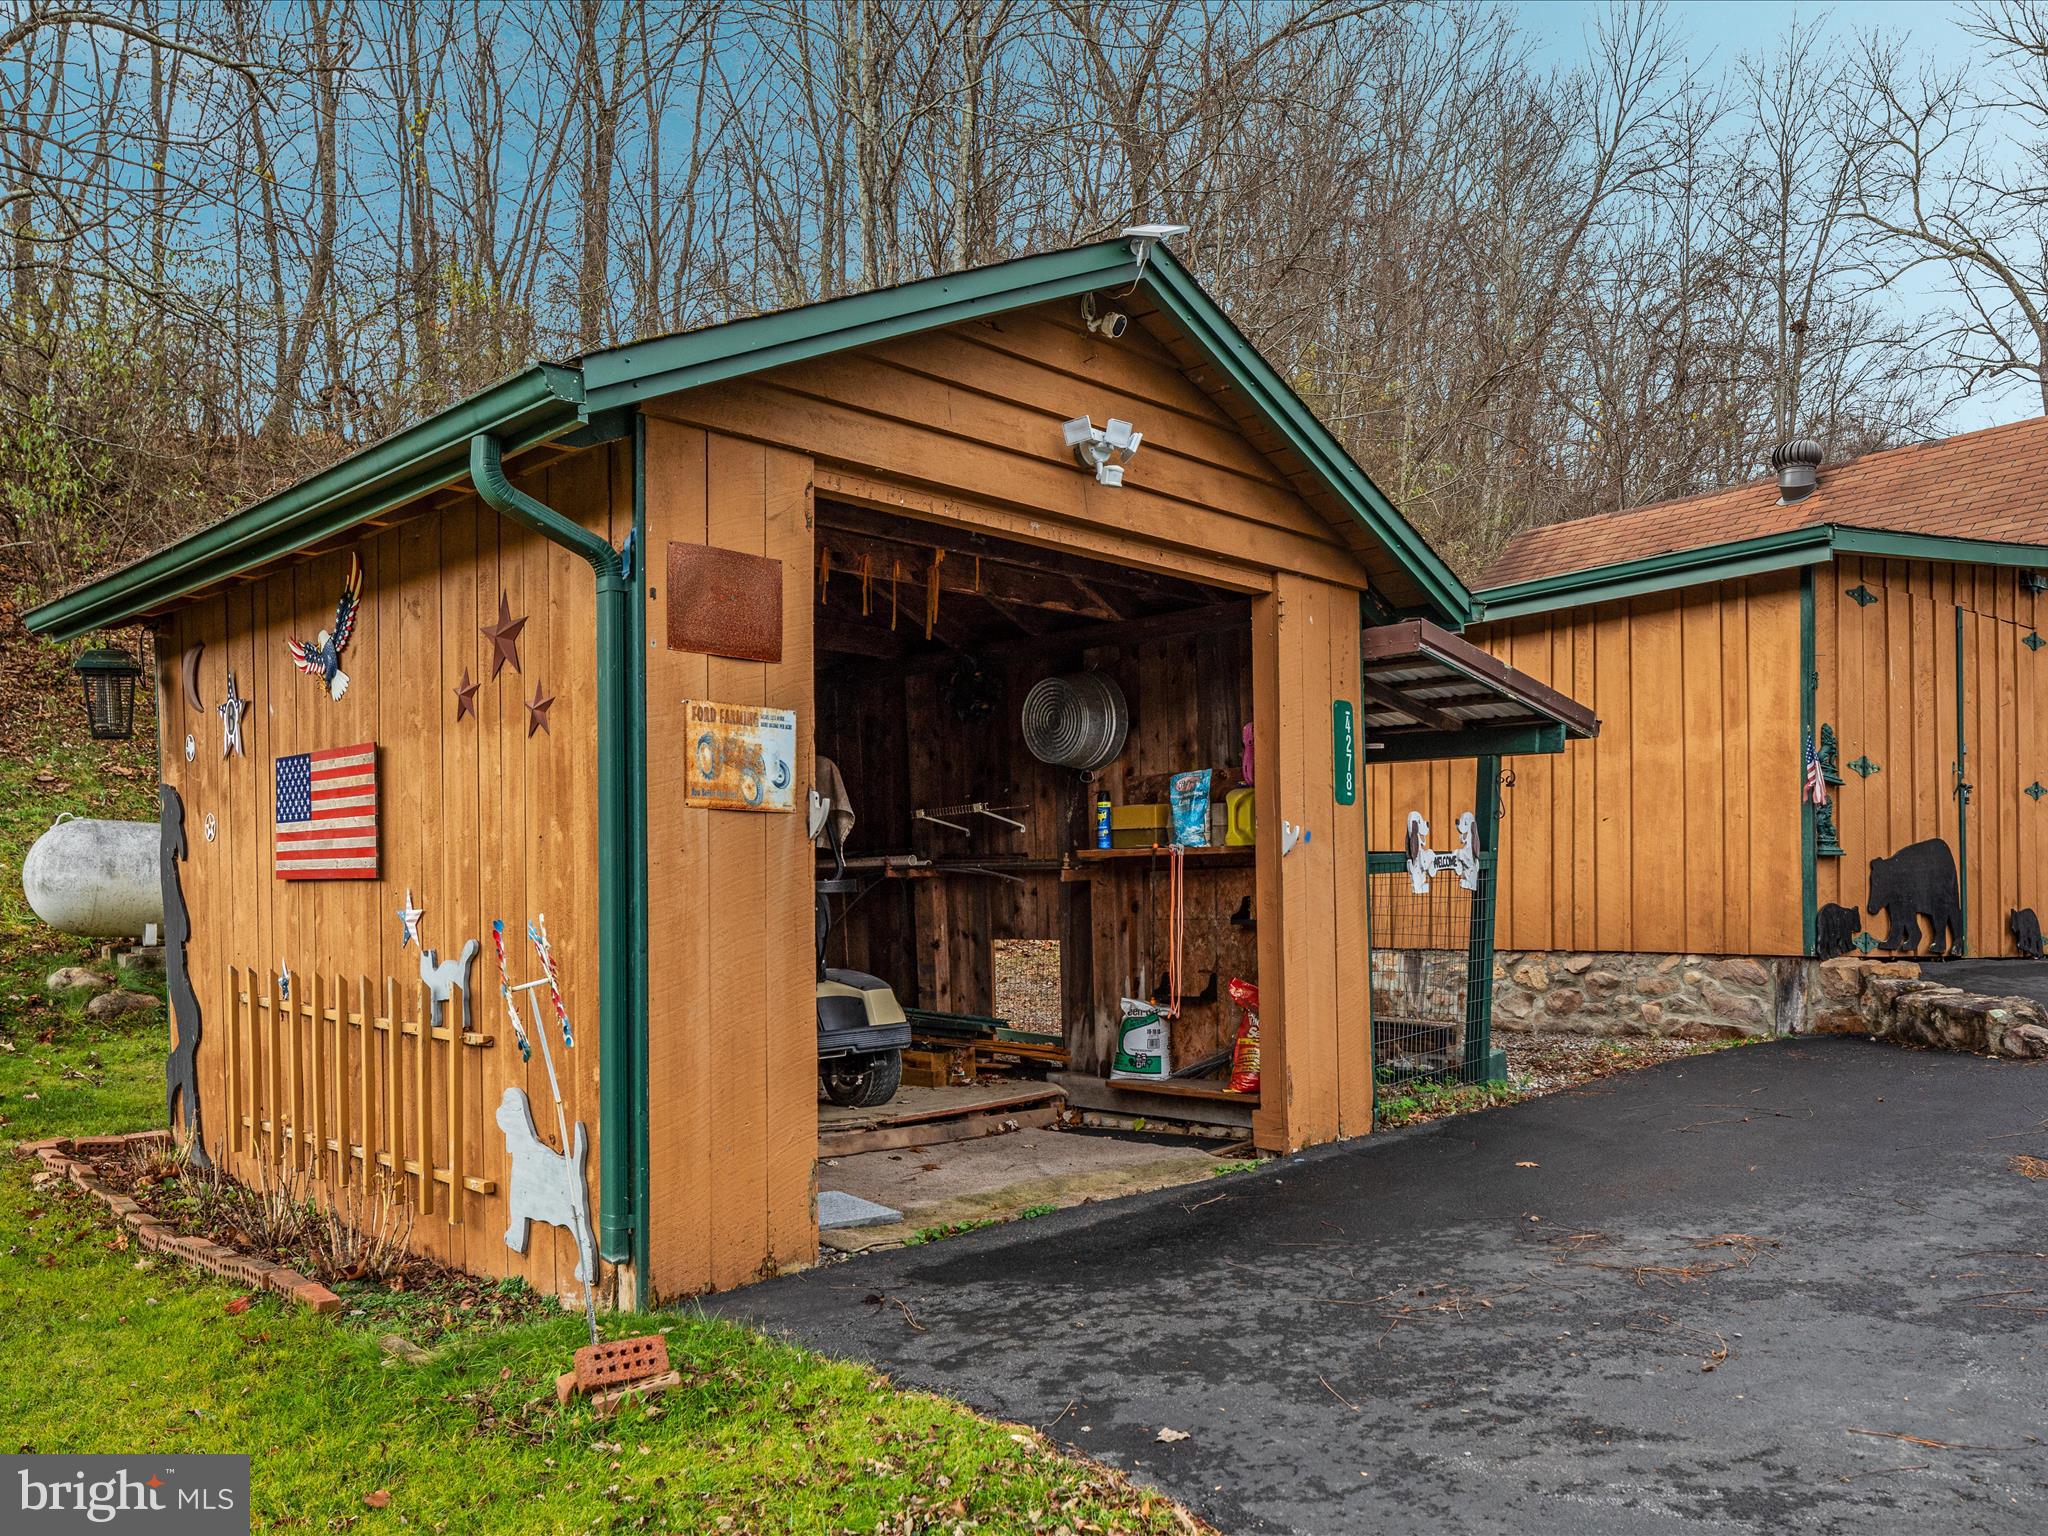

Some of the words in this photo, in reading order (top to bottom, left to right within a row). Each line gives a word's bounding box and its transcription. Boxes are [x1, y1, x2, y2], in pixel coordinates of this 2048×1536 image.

[691, 705, 717, 723] FORD
[720, 708, 760, 728] FARMING
[1434, 855, 1457, 868] WELCOME
